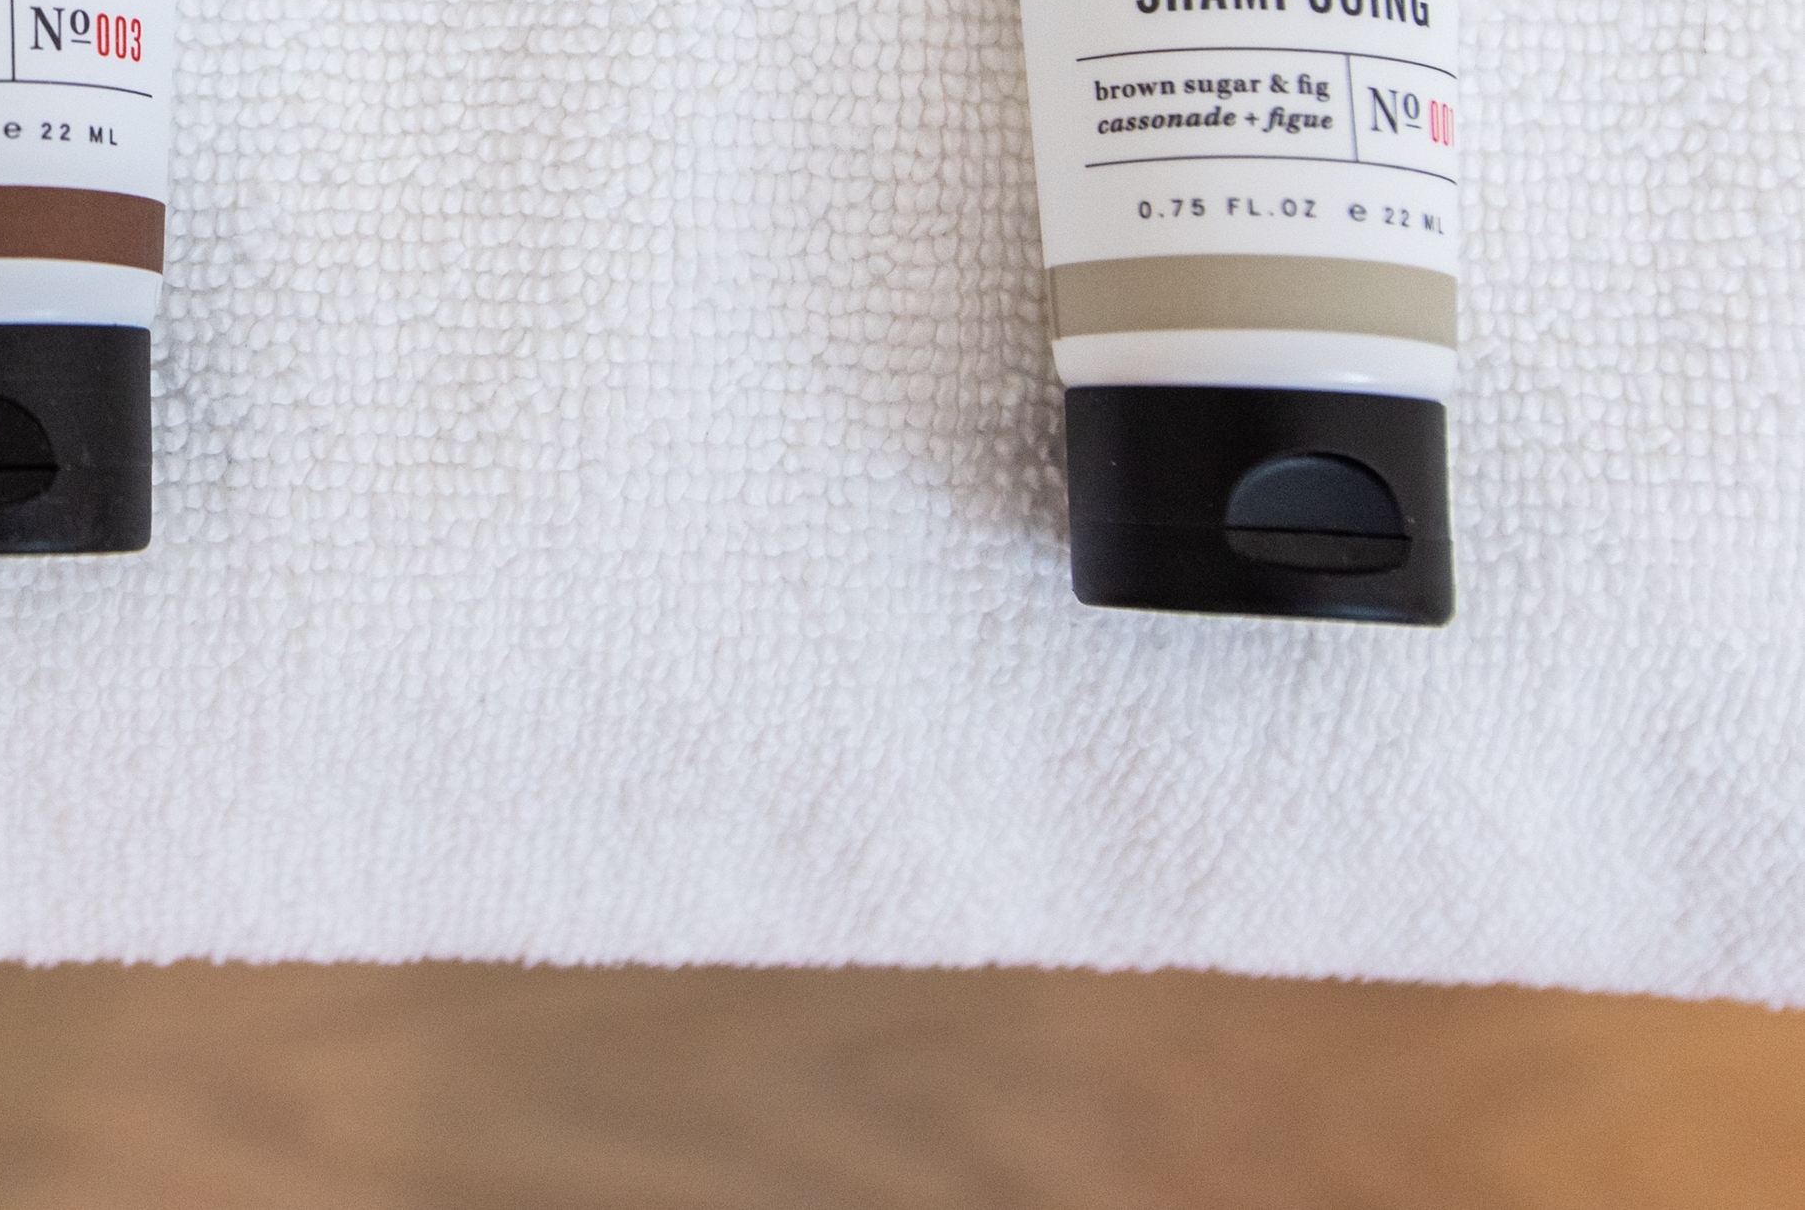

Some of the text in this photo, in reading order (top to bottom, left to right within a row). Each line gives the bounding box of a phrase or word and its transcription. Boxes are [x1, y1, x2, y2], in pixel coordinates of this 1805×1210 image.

[1094, 73, 1331, 102] brown sugar & fig
[41, 122, 71, 141] 22
[89, 125, 118, 146] ML
[1097, 105, 1333, 135] cassonade + figue
[1137, 198, 1206, 220] 0.75
[1384, 207, 1409, 228] 22
[1423, 213, 1444, 235] ML
